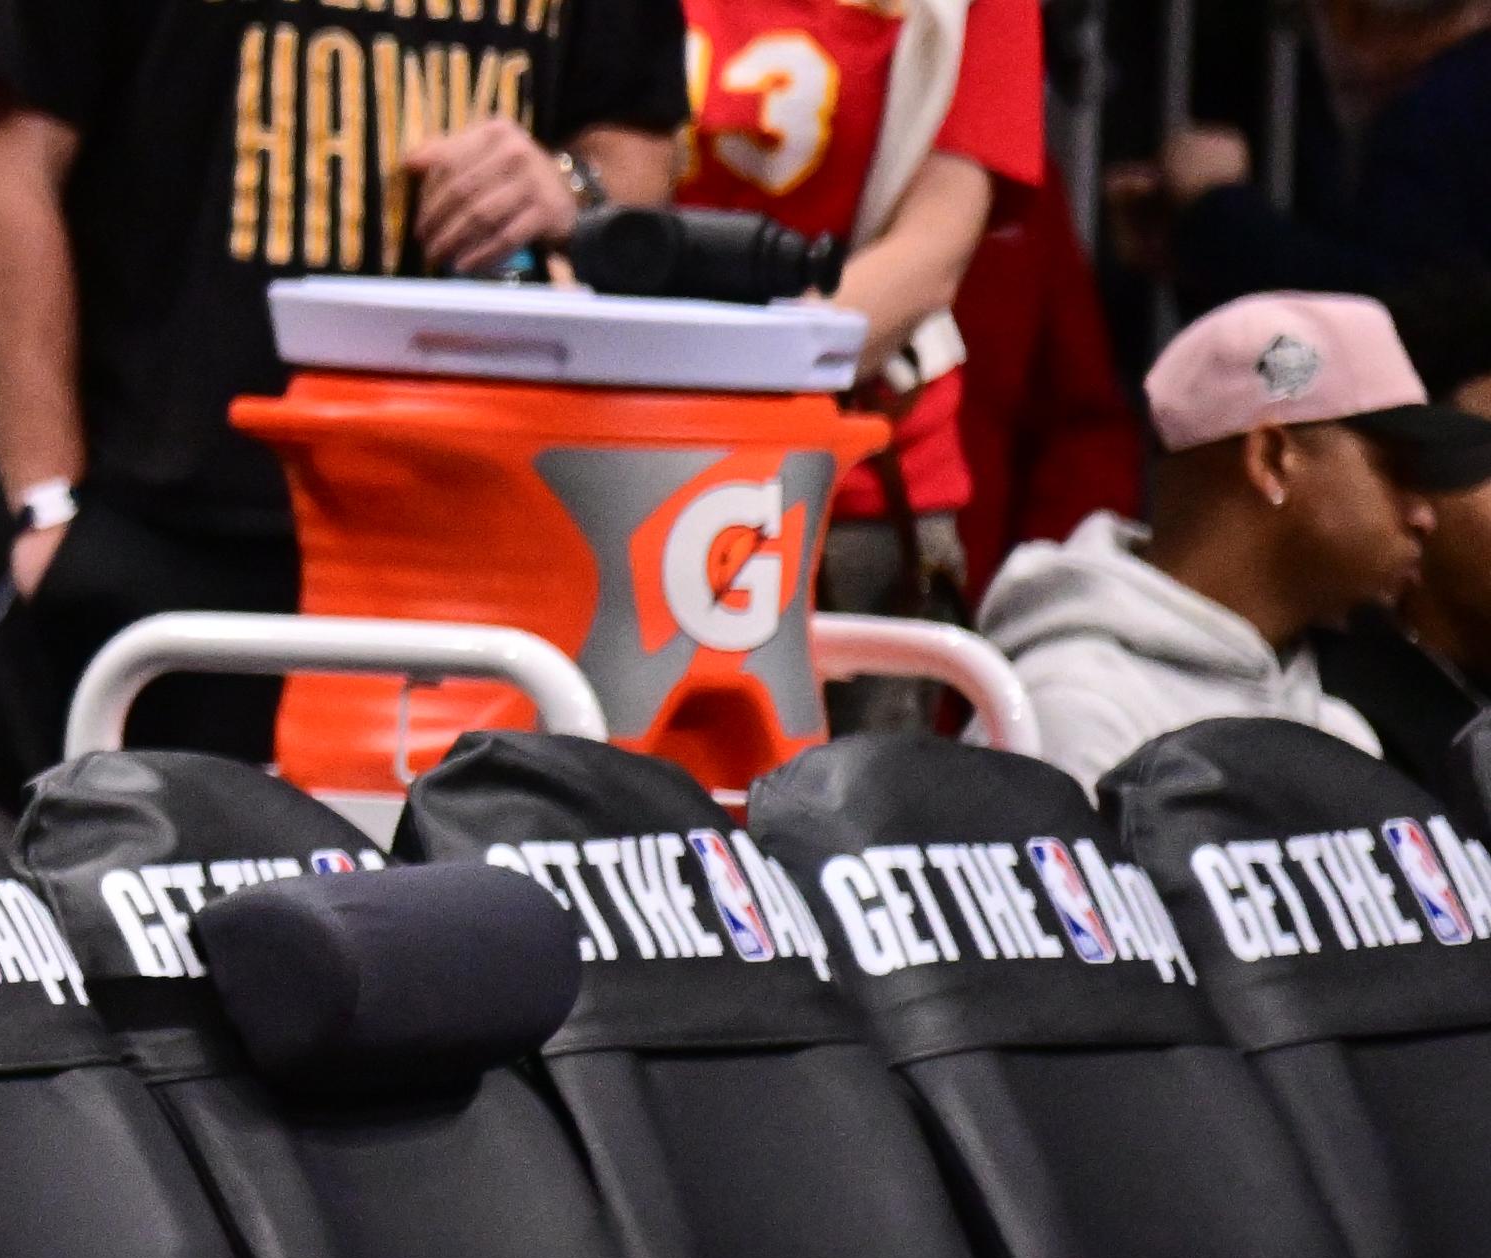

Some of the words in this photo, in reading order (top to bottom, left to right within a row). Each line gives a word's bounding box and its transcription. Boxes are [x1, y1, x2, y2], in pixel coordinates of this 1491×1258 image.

[663, 480, 782, 651] G
[582, 831, 723, 960] THE
[822, 844, 959, 976] GET
[929, 843, 1064, 960] THE
[1190, 838, 1320, 962] GET
[1285, 828, 1423, 949] THE
